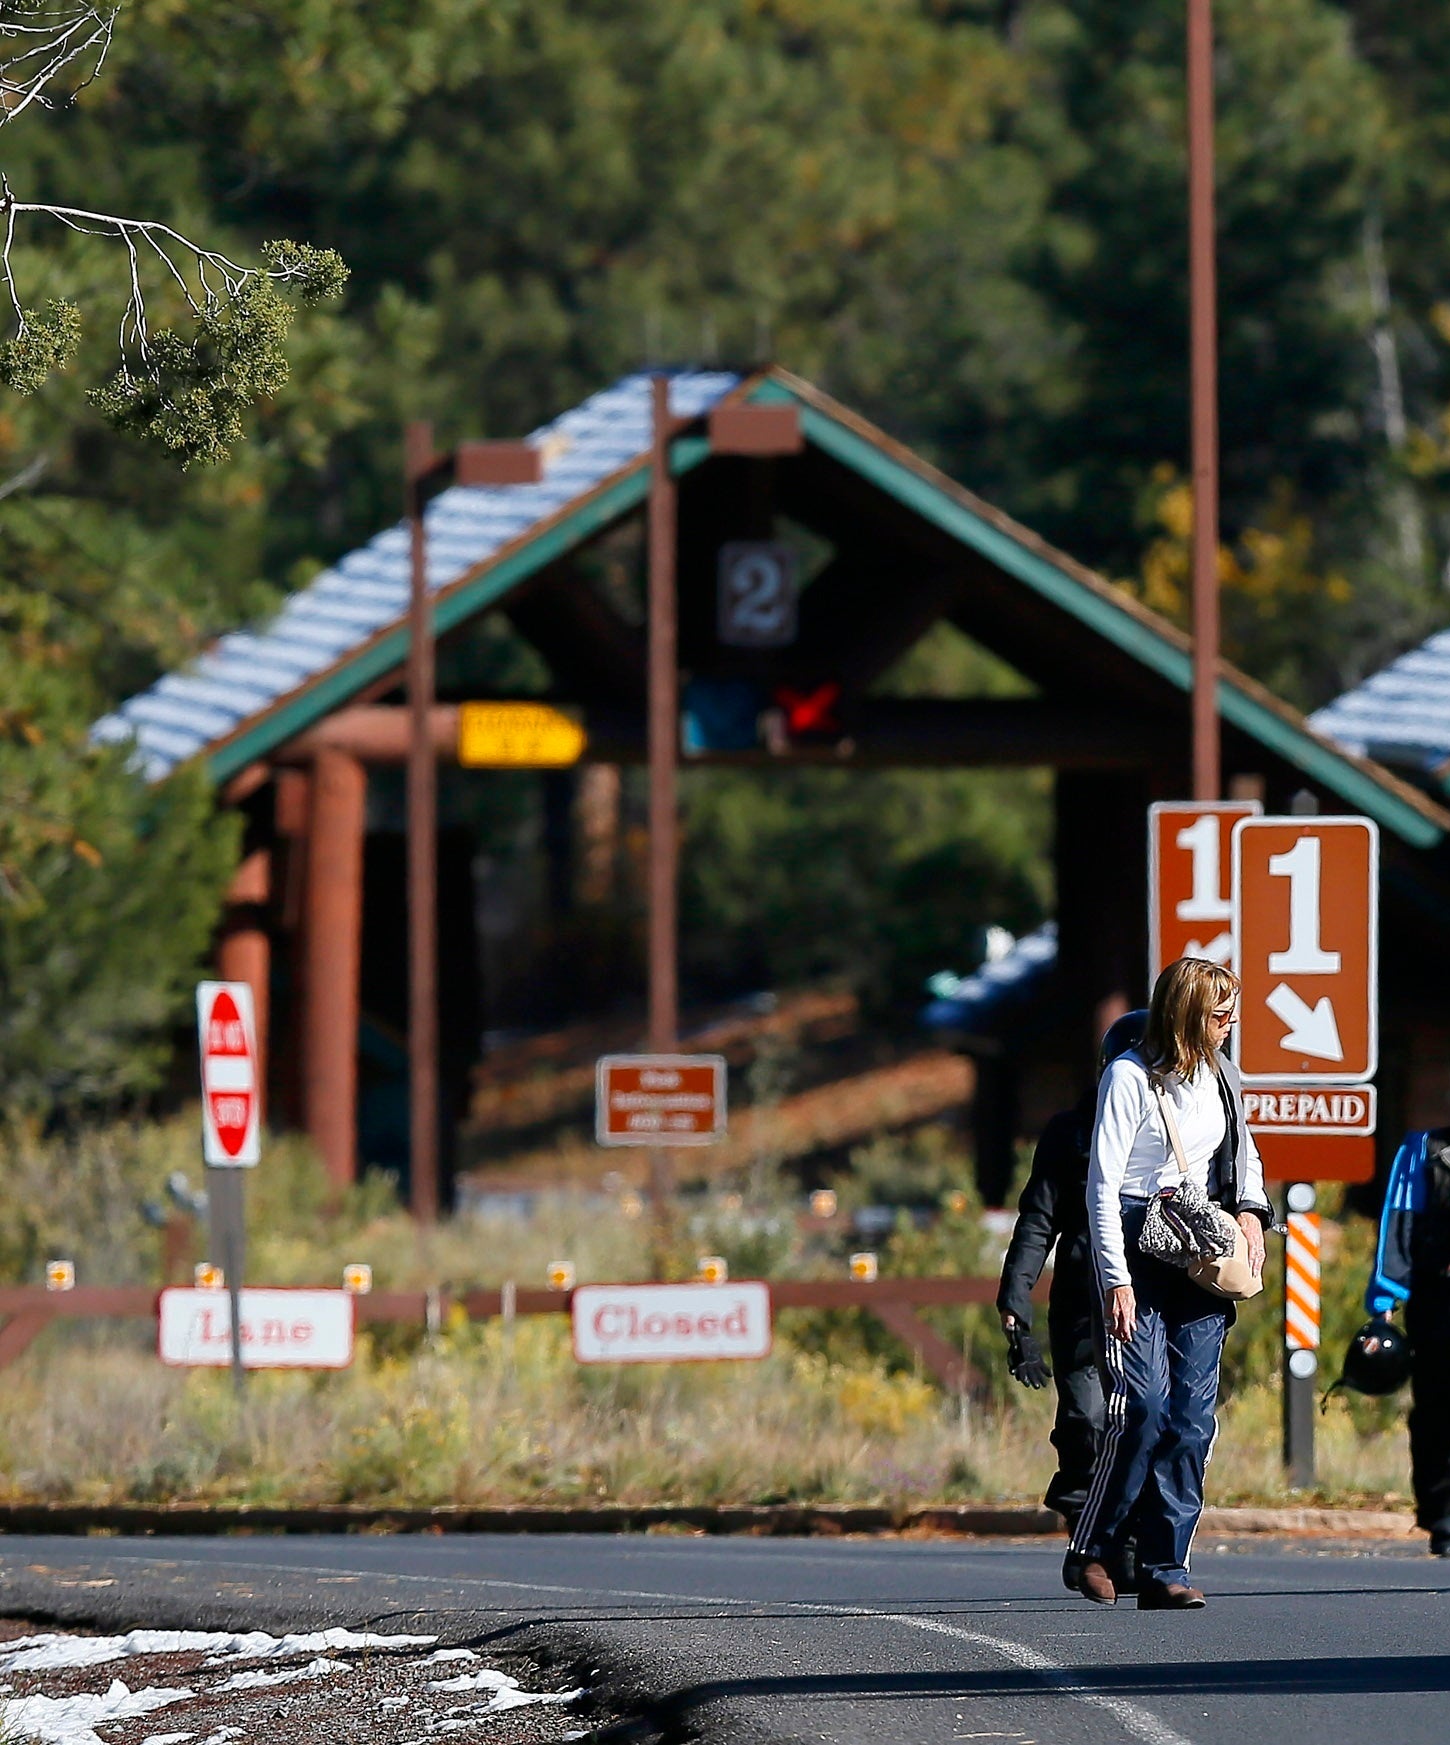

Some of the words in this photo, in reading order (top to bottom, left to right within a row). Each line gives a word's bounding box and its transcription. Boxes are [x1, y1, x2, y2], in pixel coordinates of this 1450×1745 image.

[732, 553, 781, 630] 2
[1176, 815, 1232, 921] 1
[1269, 837, 1341, 974] 1
[1243, 1093, 1365, 1123] PREPAID
[201, 1309, 313, 1344] Lane
[592, 1301, 748, 1343] Closed
